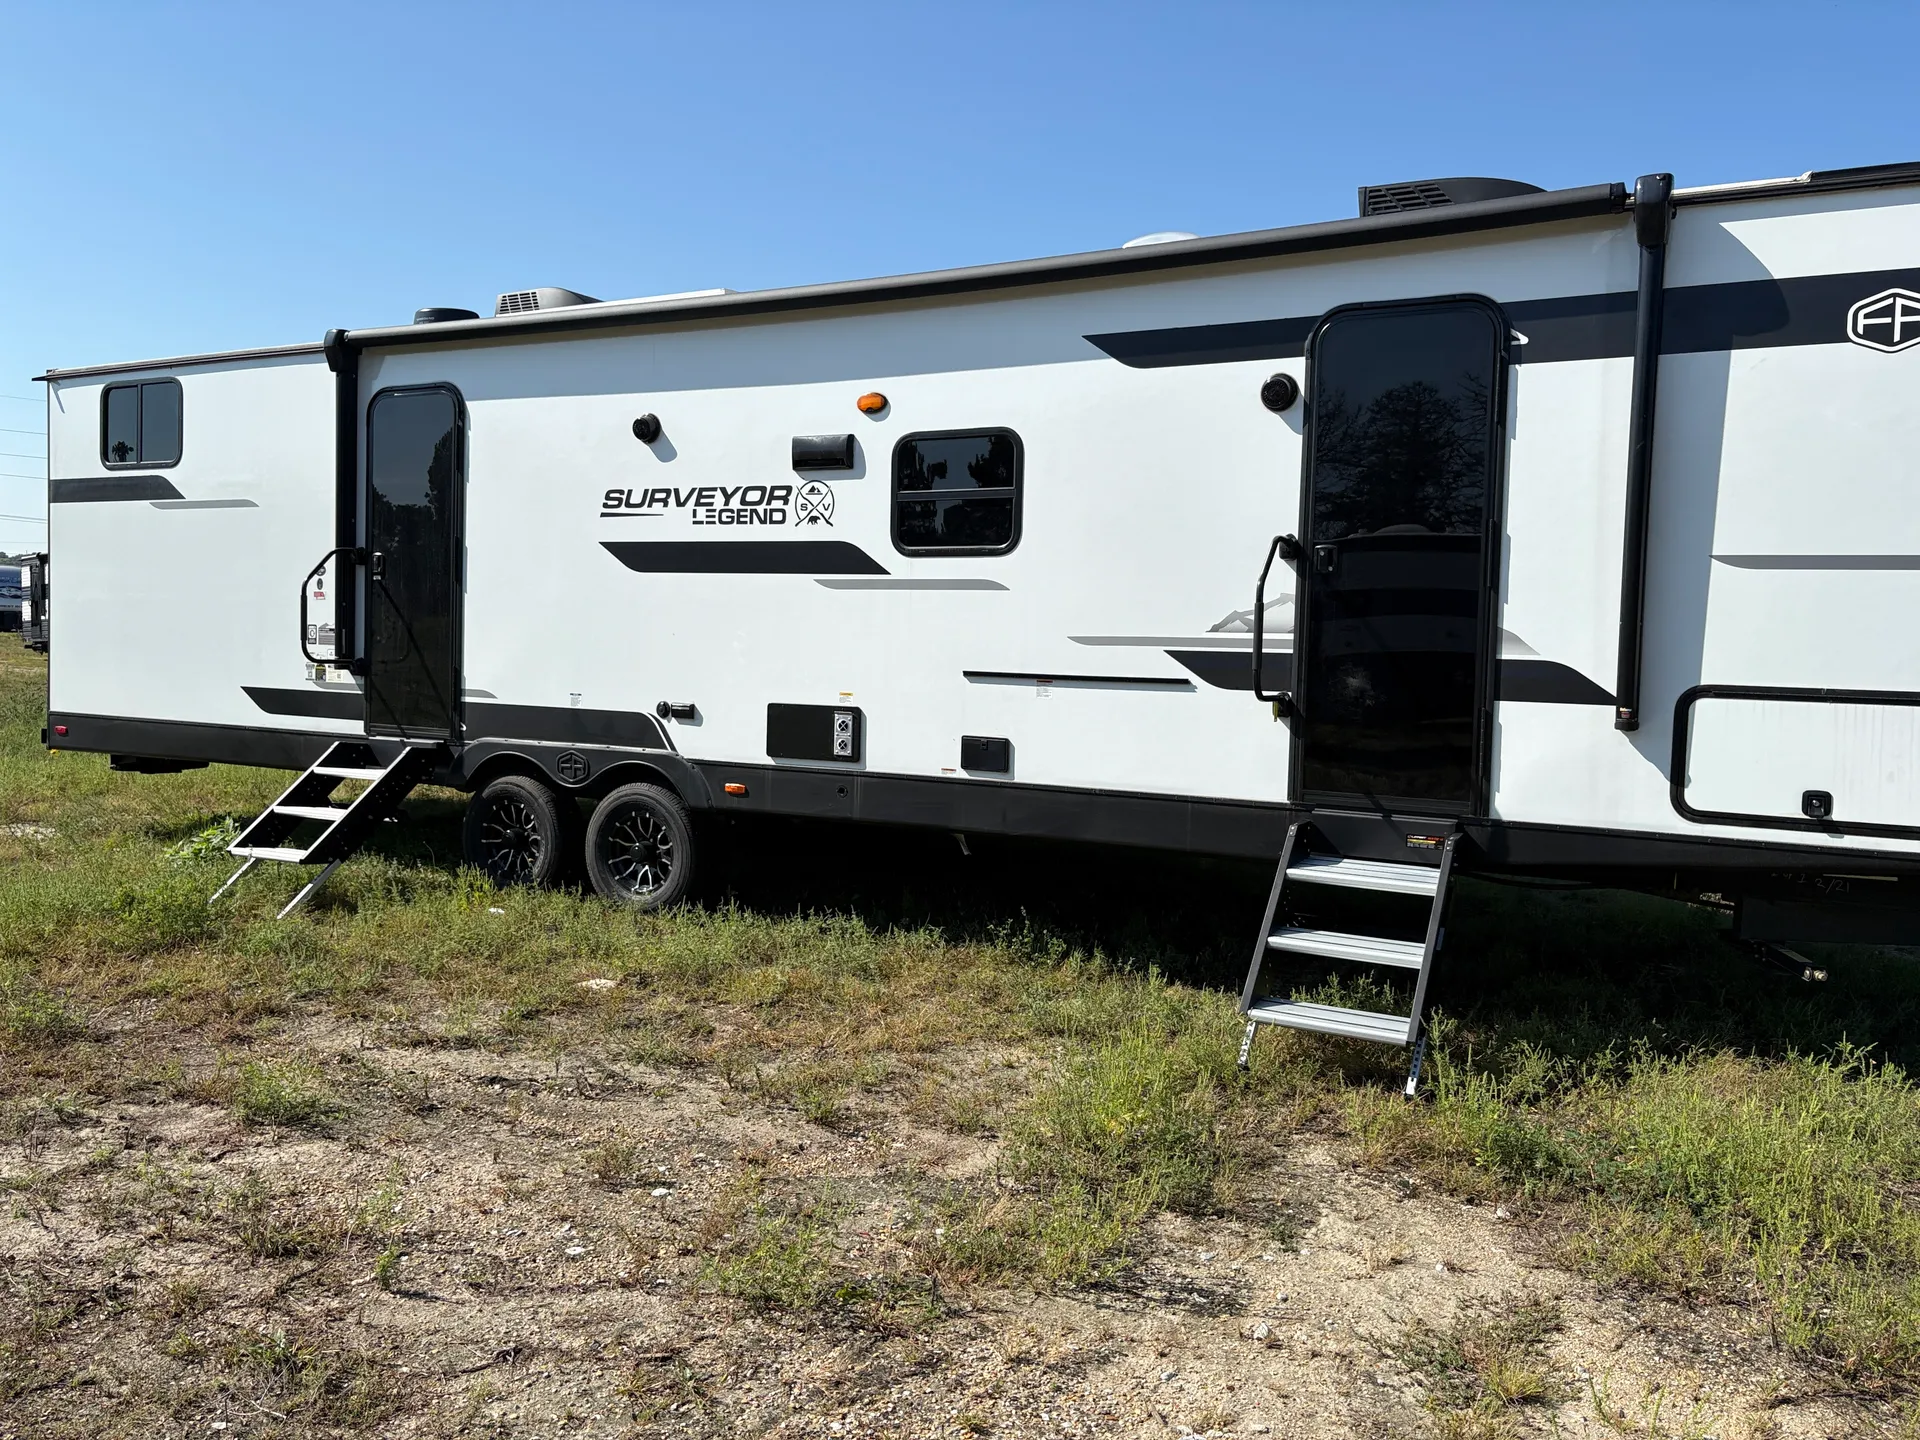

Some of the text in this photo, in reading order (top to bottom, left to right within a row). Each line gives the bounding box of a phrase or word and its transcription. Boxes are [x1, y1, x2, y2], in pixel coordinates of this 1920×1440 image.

[602, 485, 793, 509] SURVEYOR
[800, 503, 831, 511] S V
[692, 508, 787, 525] LEGEND
